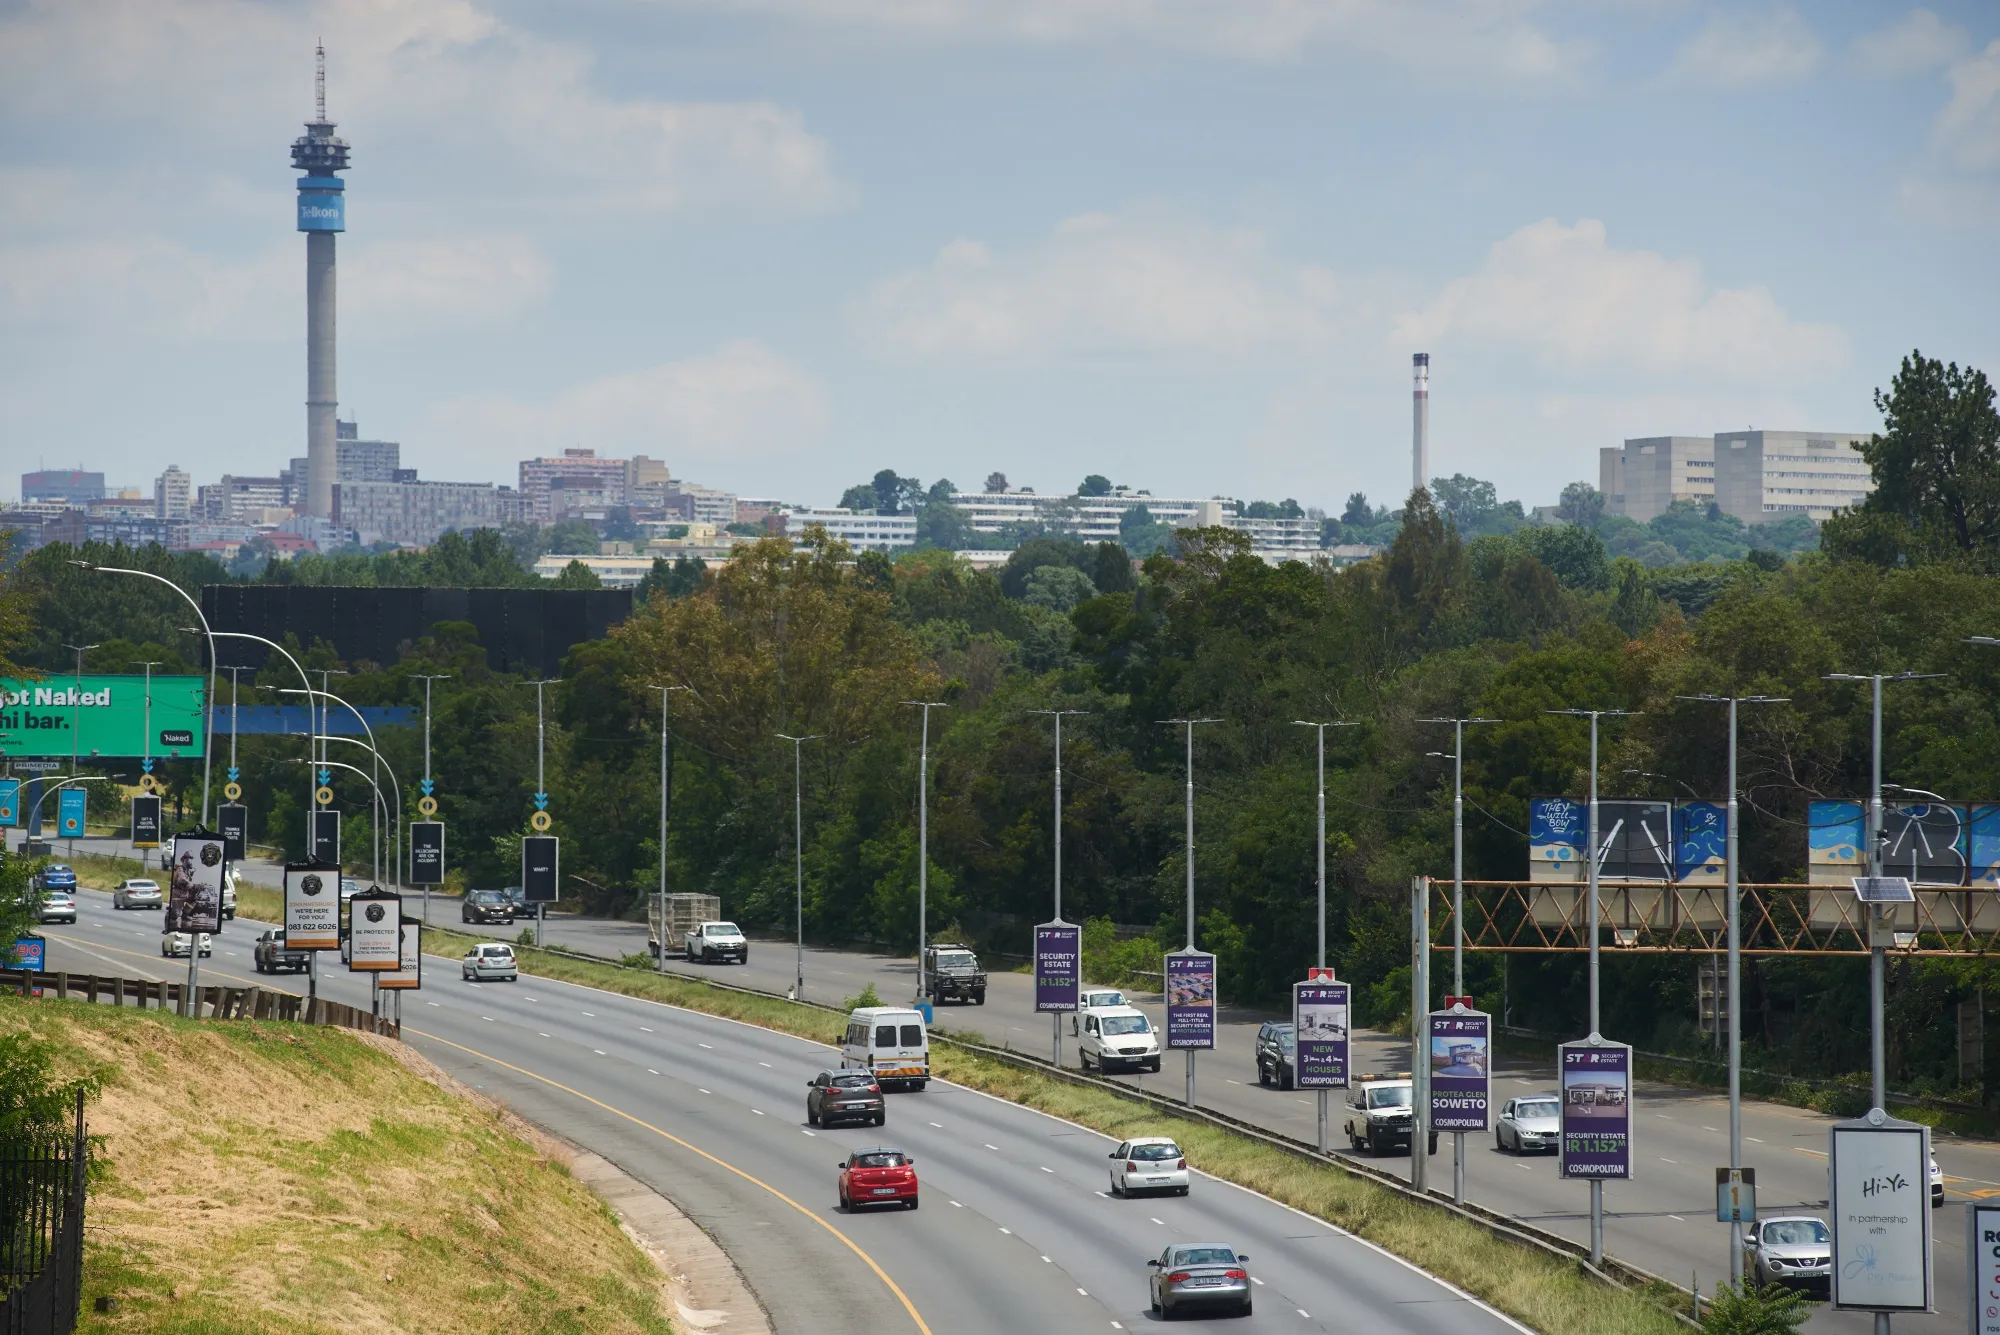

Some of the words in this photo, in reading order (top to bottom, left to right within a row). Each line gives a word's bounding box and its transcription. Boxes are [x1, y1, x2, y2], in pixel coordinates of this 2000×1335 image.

[301, 206, 339, 218] Telkom
[34, 687, 111, 707] Naked
[24, 711, 70, 729] bar.
[1542, 802, 1570, 813] THEY
[288, 923, 301, 931] 083
[1301, 1076, 1345, 1085] COSMOPOLITAN
[1432, 1099, 1487, 1109] SOWETO
[1435, 1118, 1484, 1127] COSMOPOLITAN
[1600, 1132, 1626, 1140] ESTATE
[1568, 1164, 1625, 1174] COSMOPOLITAN
[1731, 1171, 1740, 1182] M
[1731, 1186, 1739, 1206] 1
[1848, 1214, 1857, 1222] In
[1858, 1214, 1908, 1225] partnership
[1869, 1227, 1887, 1235] with
